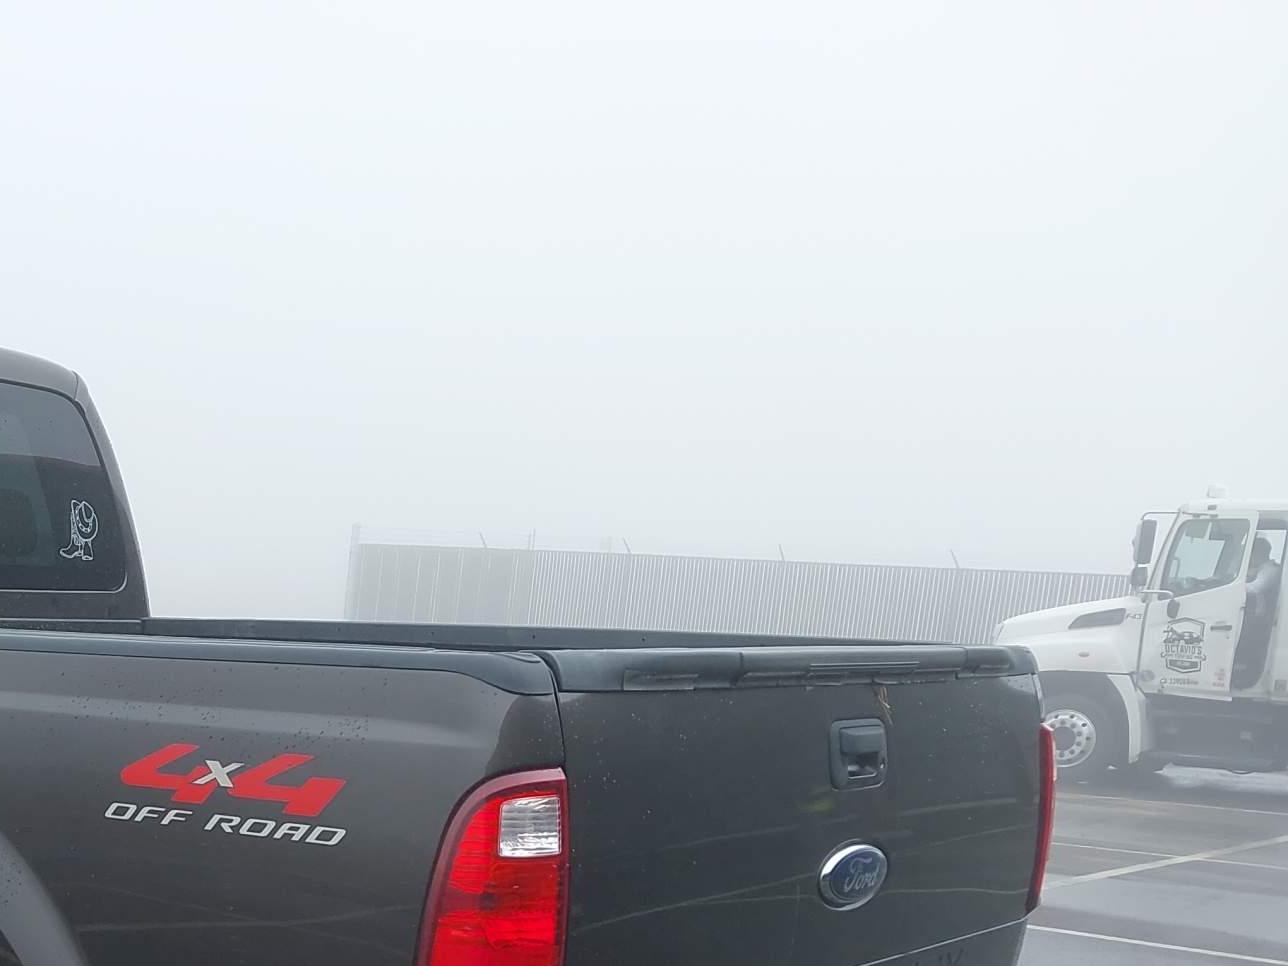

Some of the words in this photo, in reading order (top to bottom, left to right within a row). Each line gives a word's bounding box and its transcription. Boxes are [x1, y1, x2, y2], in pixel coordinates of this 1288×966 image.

[105, 802, 193, 825] OFF
[204, 814, 347, 846] ROAD
[843, 857, 881, 893] Ford
